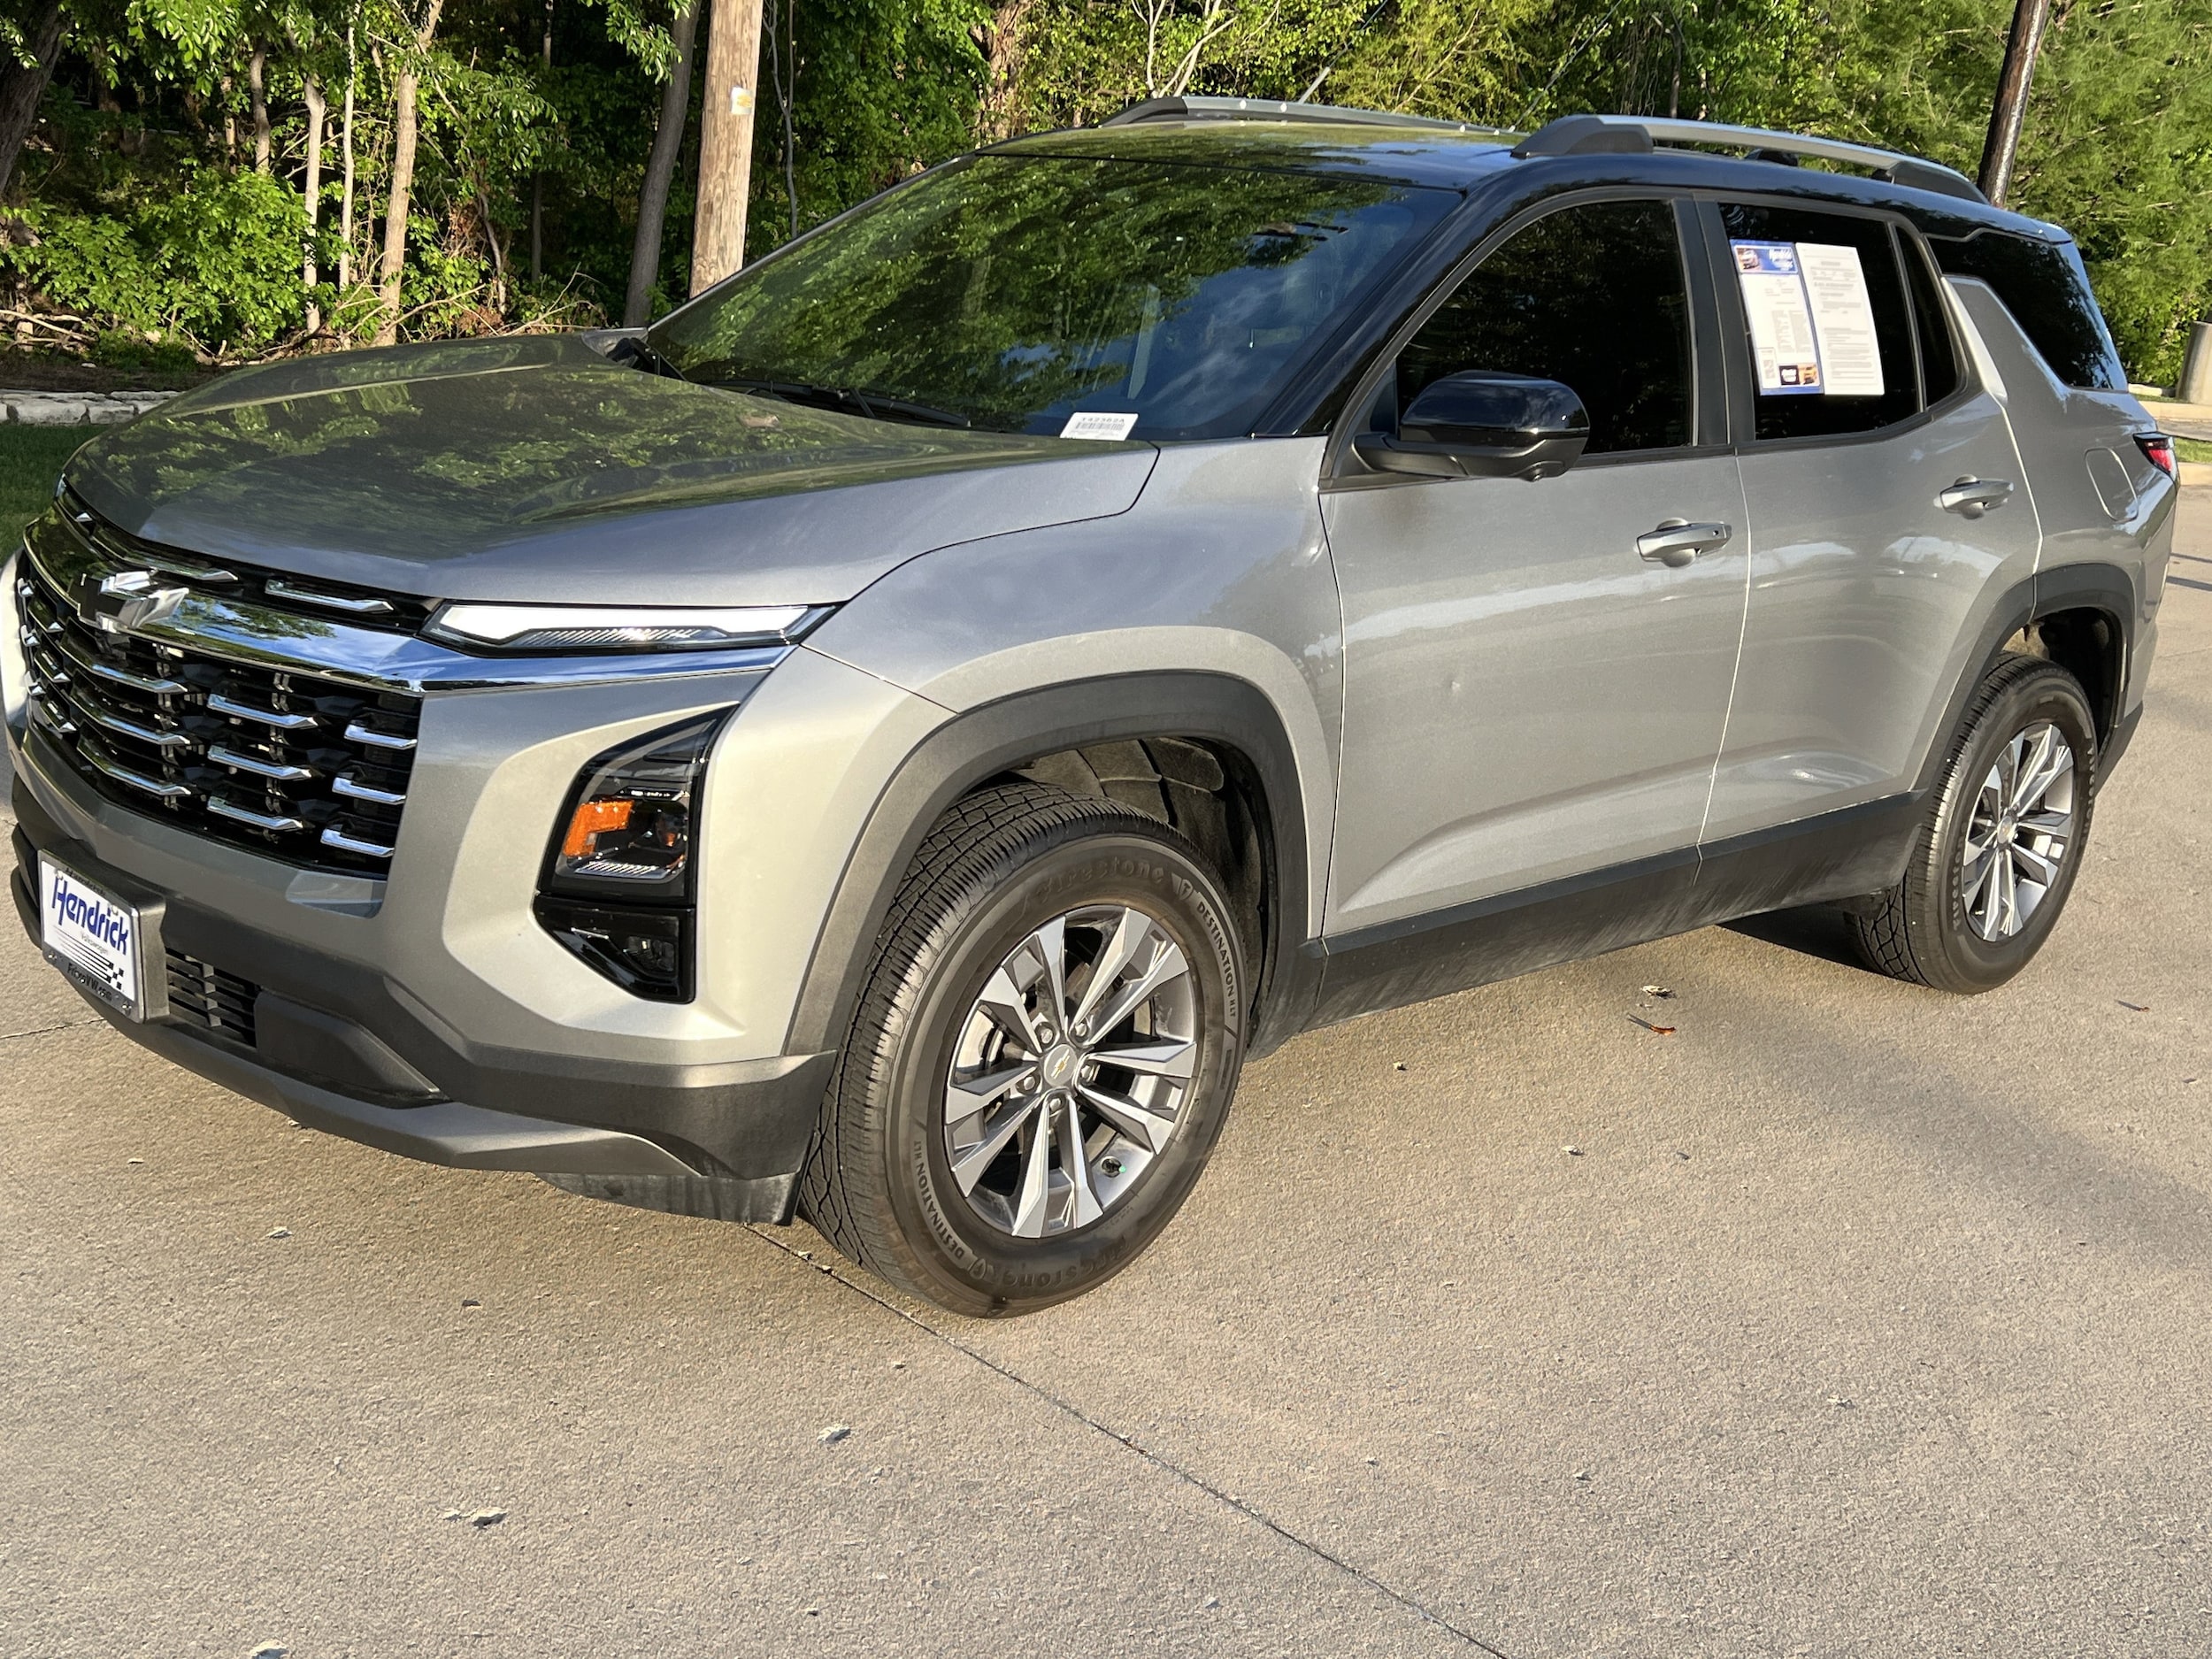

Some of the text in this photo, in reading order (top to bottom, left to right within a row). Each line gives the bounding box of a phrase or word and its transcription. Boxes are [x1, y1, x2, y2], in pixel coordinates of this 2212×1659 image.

[51, 875, 128, 956] Hendrick
[1196, 901, 1234, 997] DESTINATION
[917, 1162, 965, 1260] DESTINATION
